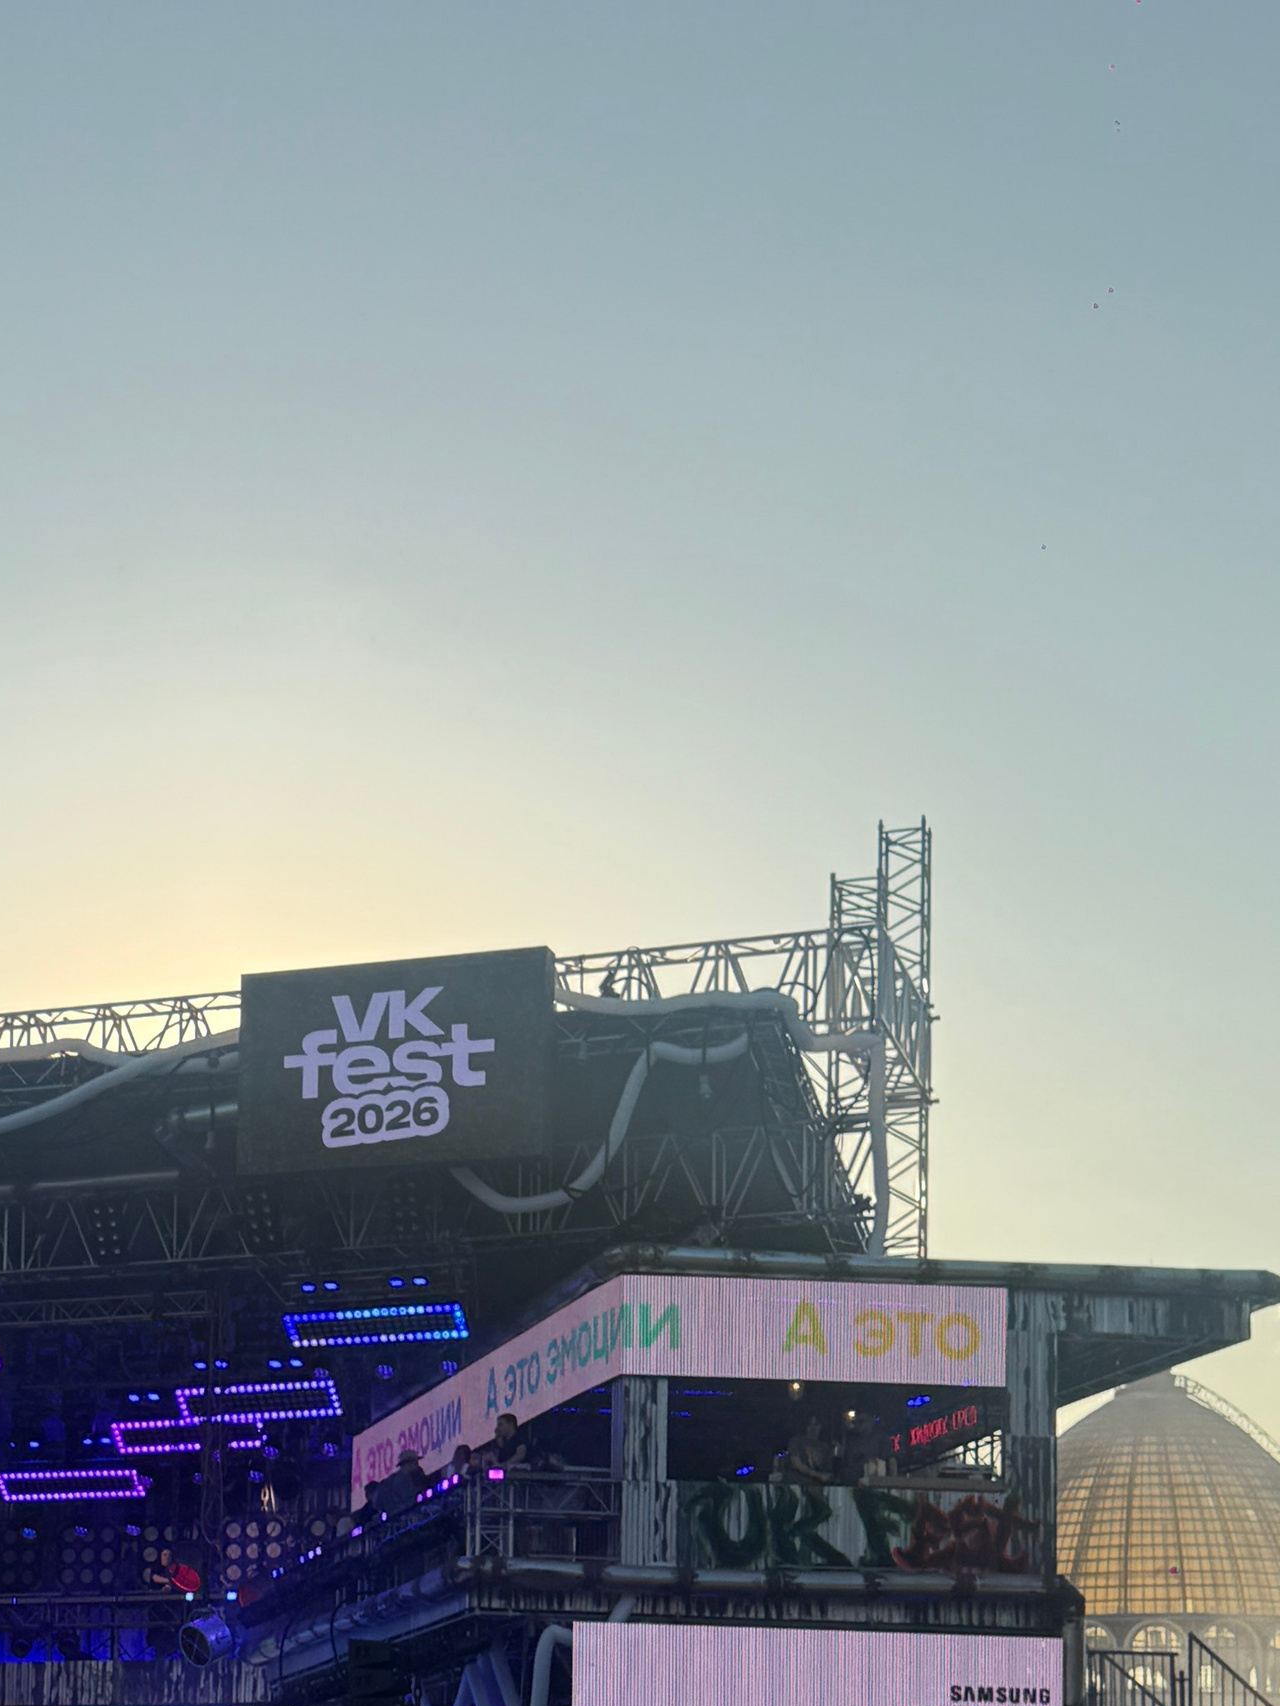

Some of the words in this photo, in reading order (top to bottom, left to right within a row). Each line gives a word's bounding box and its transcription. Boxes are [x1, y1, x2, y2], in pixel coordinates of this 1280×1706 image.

[331, 985, 445, 1043] VK
[283, 1023, 495, 1099] fest
[328, 1095, 440, 1139] 2026
[783, 1299, 828, 1355] А
[854, 1309, 982, 1361] ЭТО
[484, 1366, 499, 1419] А
[504, 1351, 541, 1408] ЭТО
[545, 1302, 681, 1385] ЭМОЦИИ
[950, 1685, 1051, 1705] SAMSUNG
